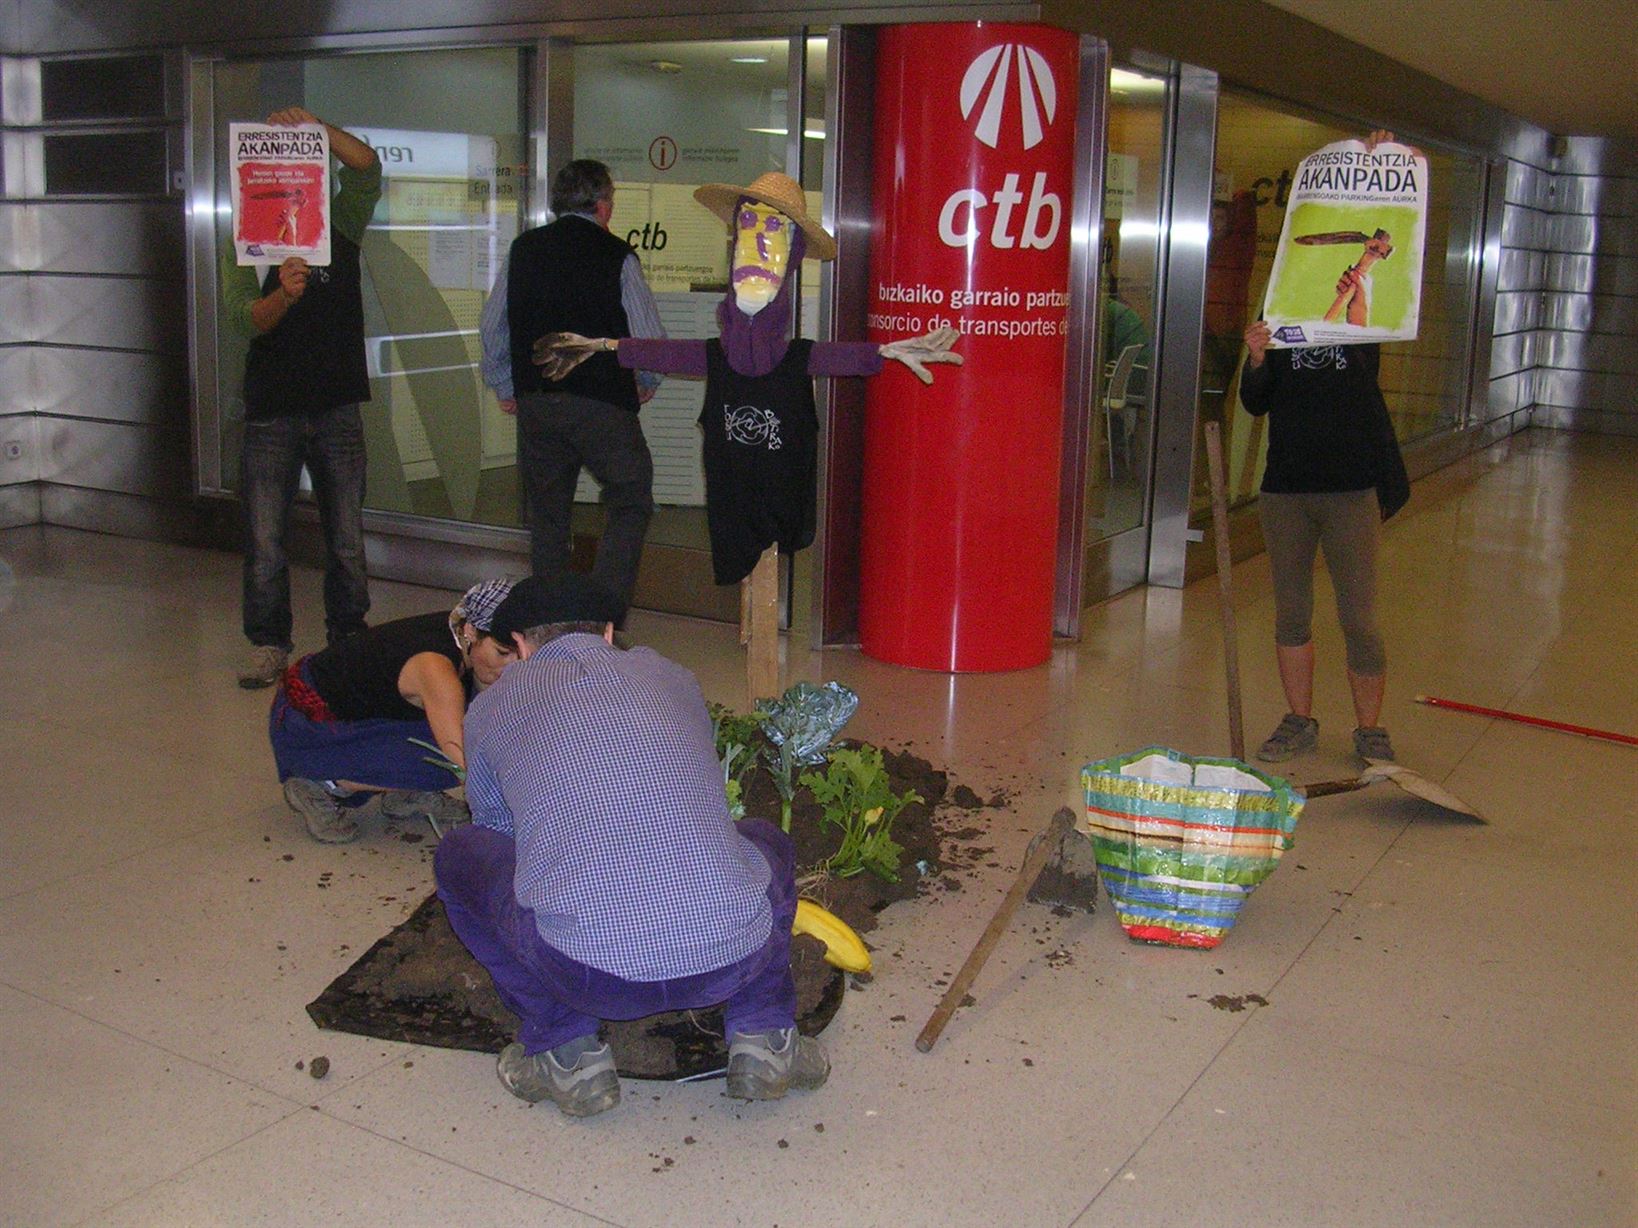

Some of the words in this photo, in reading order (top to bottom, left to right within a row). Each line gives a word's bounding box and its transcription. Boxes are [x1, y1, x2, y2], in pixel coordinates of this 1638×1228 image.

[238, 131, 323, 141] ERRESISTENTZIA
[238, 142, 323, 155] AKANPADA
[1305, 151, 1417, 167] ERRESISTENTZIA
[1298, 168, 1417, 192] AKANPADA
[938, 172, 1061, 250] ctb
[627, 221, 667, 250] ctb
[879, 282, 943, 304] bizkaiko
[950, 287, 1020, 310] garraio
[959, 315, 1056, 340] transportes
